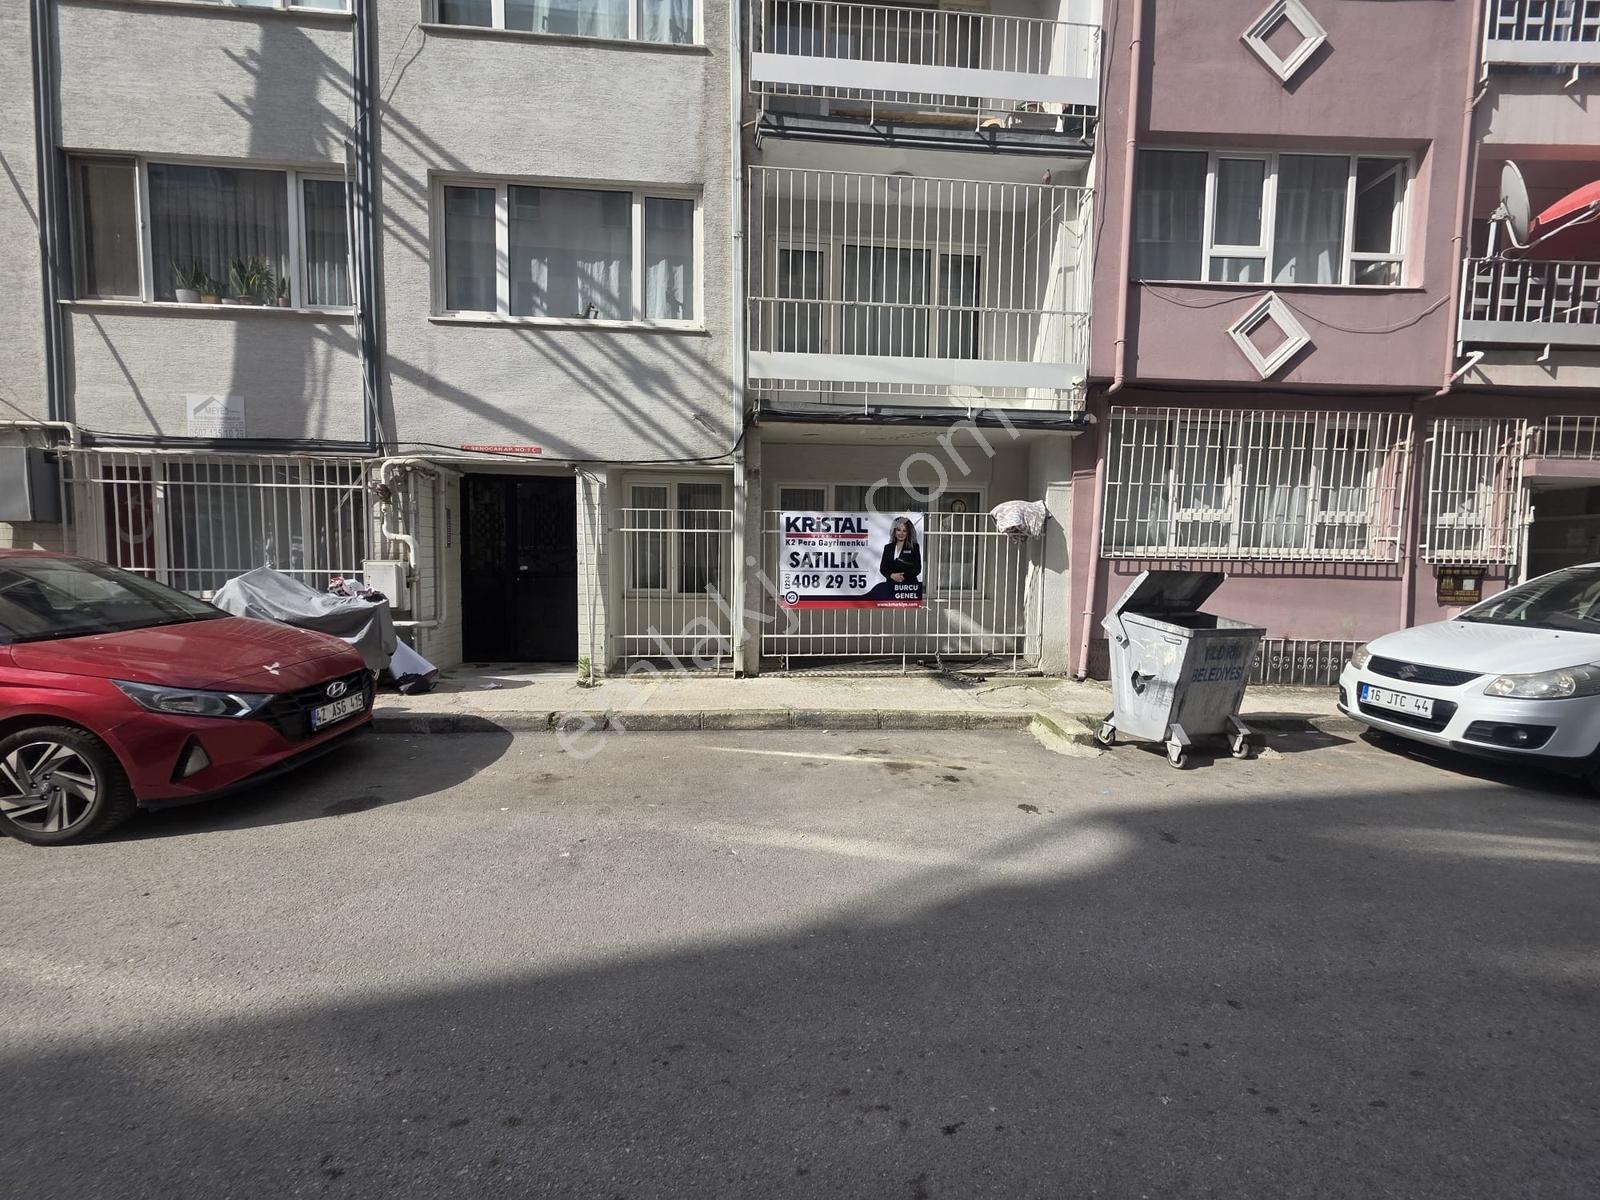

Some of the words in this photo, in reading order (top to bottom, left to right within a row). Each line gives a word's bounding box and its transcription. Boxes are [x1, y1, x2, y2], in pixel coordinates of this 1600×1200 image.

[798, 539, 816, 547] Pera
[819, 539, 869, 548] Gayrimenkul
[789, 551, 859, 569] SATILIK
[792, 574, 821, 589] 408
[825, 574, 844, 589] 29
[849, 574, 867, 589] 55
[332, 700, 347, 718] ASG
[1370, 688, 1382, 702] 16
[1386, 693, 1407, 707] JTC
[1414, 698, 1429, 713] 44
